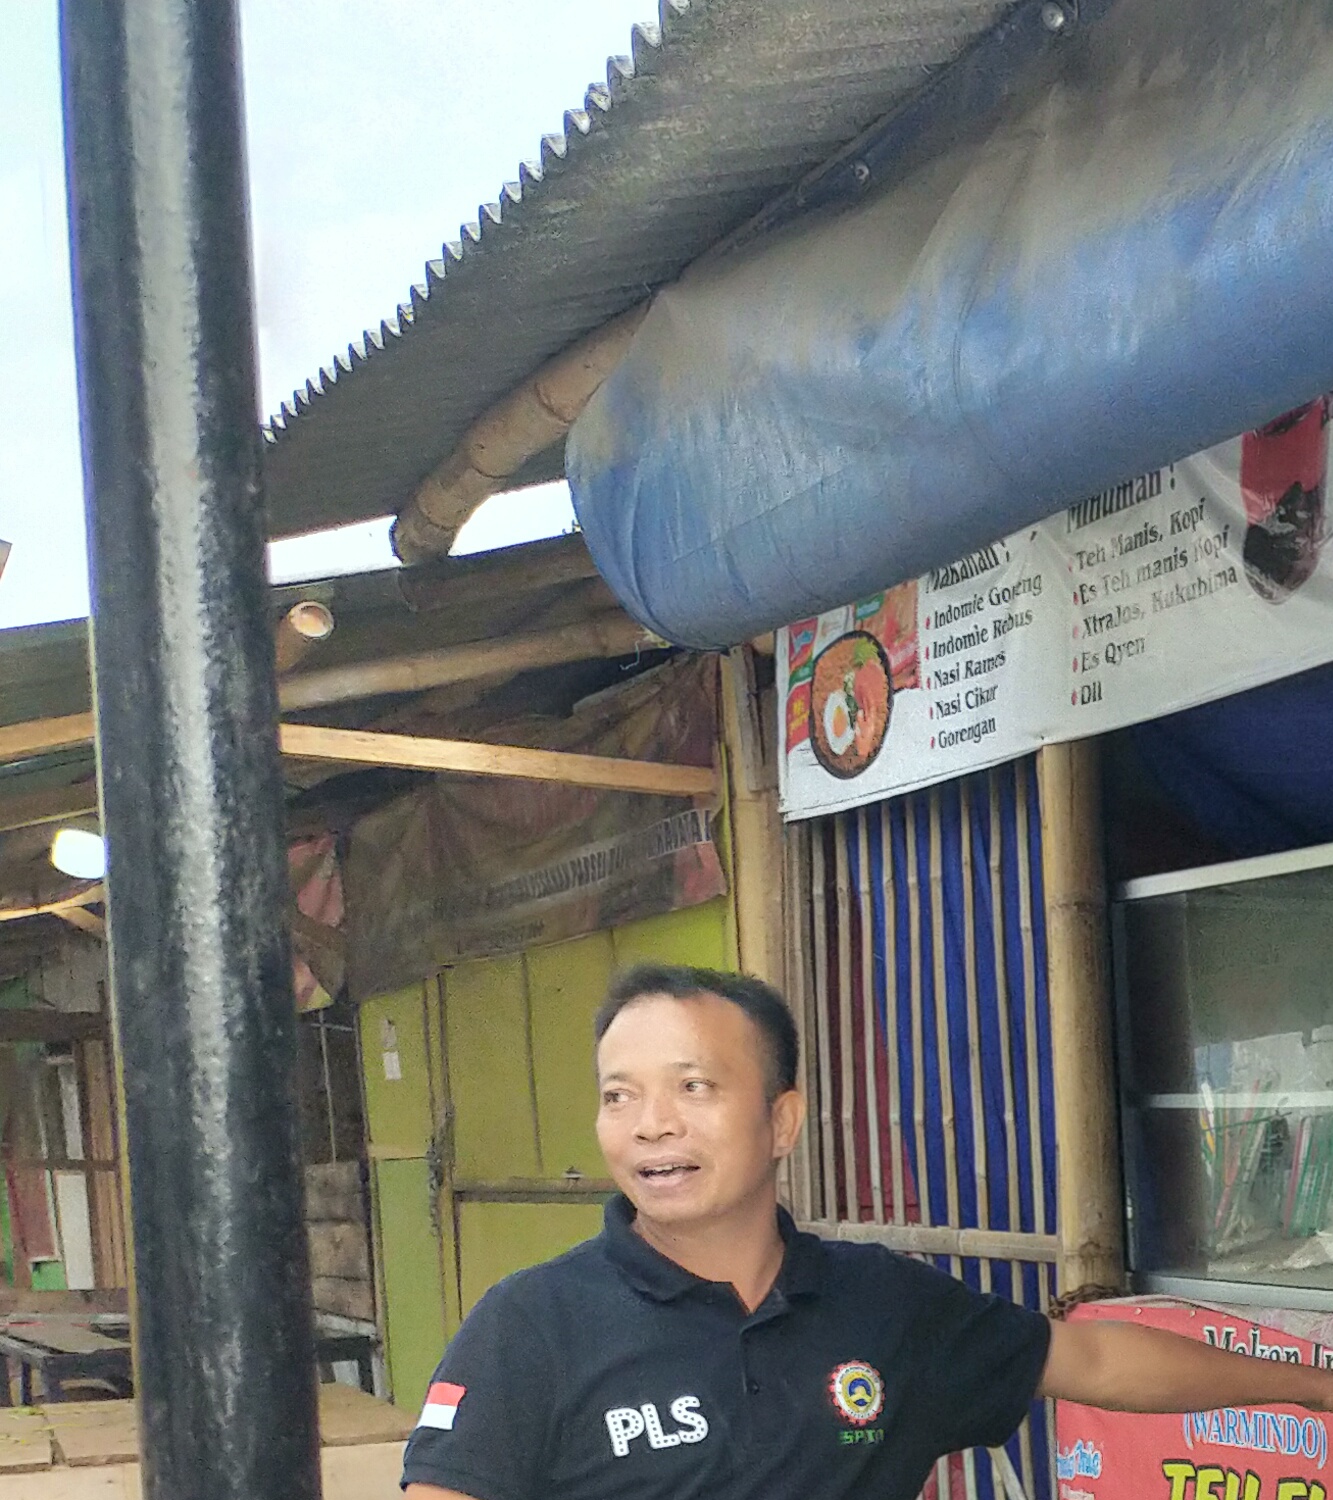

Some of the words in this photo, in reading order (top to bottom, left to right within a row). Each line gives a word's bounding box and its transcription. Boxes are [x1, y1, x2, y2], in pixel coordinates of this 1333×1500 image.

[1077, 547, 1106, 571] Teh
[1170, 498, 1206, 535] Kopi
[1079, 584, 1097, 606] Es
[1102, 570, 1130, 594] Teh
[1137, 547, 1188, 582] manis
[1194, 524, 1230, 563] Kopi
[934, 596, 984, 629] Indomie
[989, 574, 1042, 606] Goreng
[933, 629, 989, 659] Indomie
[993, 609, 1033, 641] Rebus
[934, 663, 960, 688] Nasi
[965, 653, 1006, 680] Rames
[1081, 652, 1100, 673] Es
[935, 693, 961, 719] Nasi
[938, 716, 996, 748] Gorengan
[606, 1396, 709, 1457] PLS
